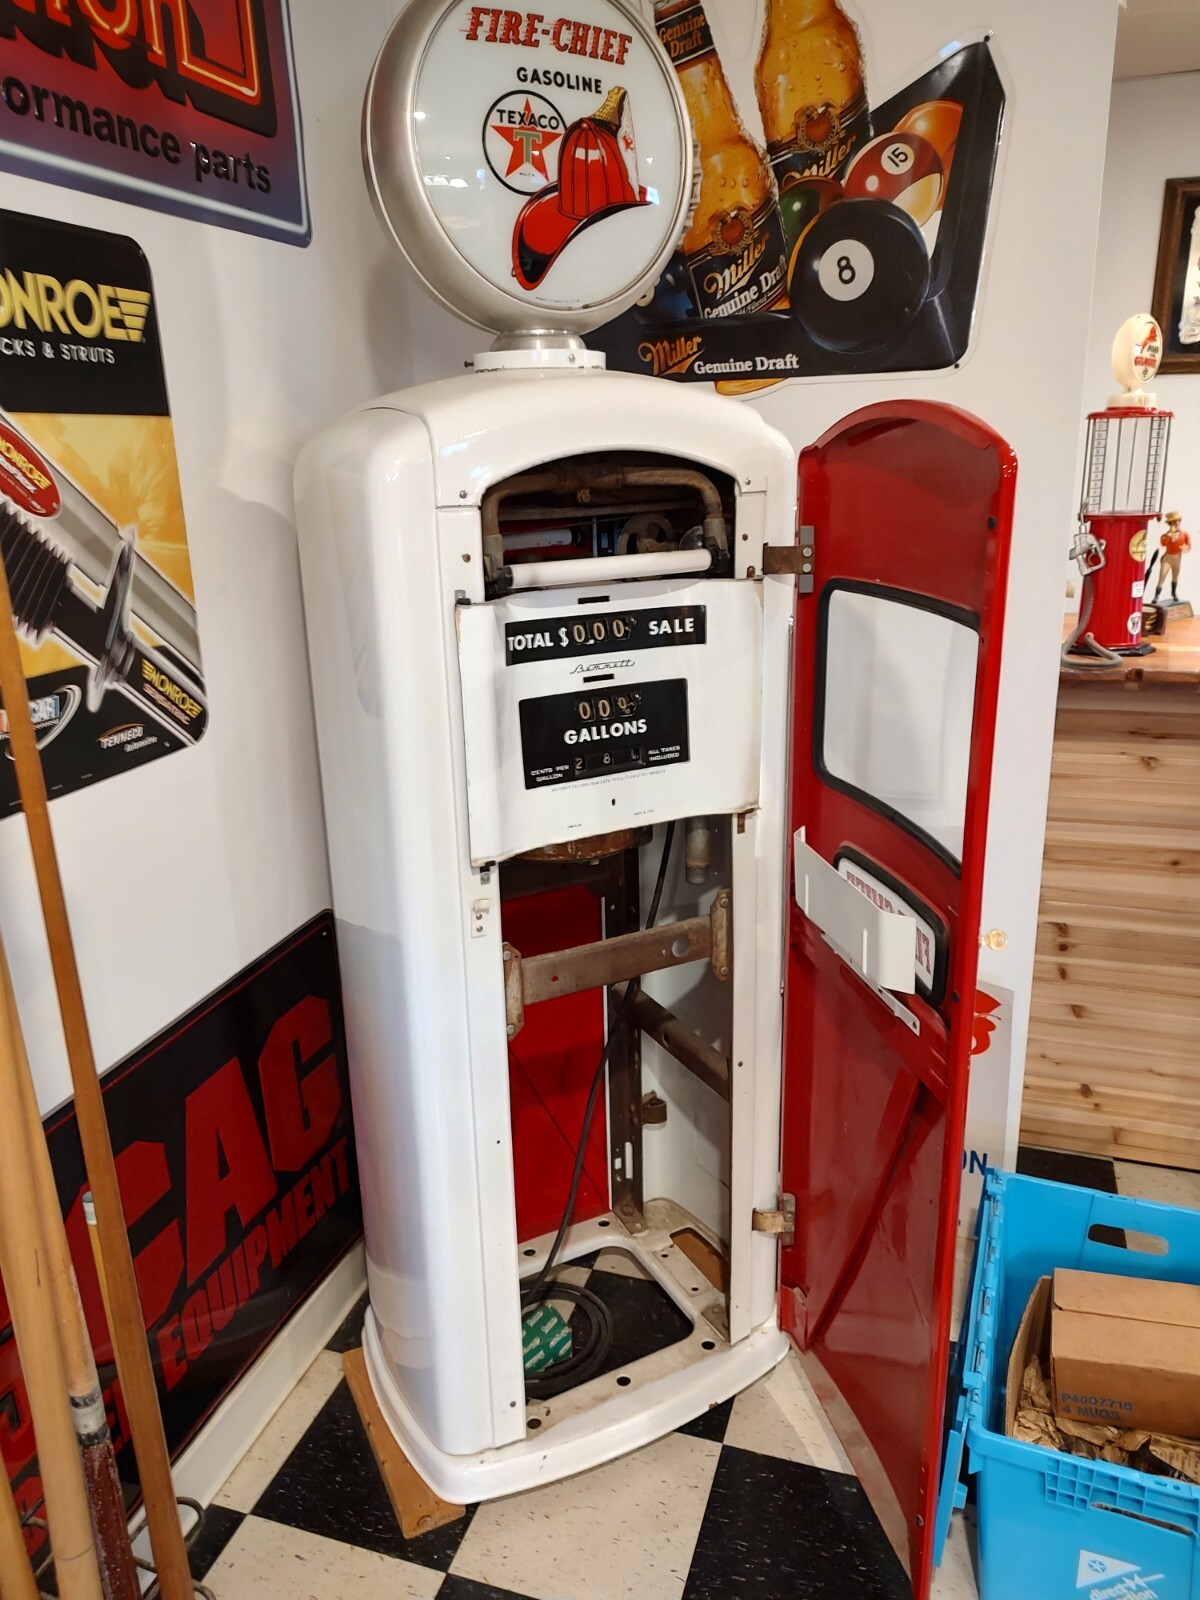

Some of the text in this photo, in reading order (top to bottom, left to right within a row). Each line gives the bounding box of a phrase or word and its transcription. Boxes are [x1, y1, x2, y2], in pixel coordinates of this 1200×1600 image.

[464, 5, 633, 66] FIRE-CHIEF
[659, 14, 706, 44] Genuine
[670, 30, 703, 58] Draft
[516, 66, 603, 95] GASOLINE
[496, 108, 560, 131] TEXACO
[190, 141, 271, 194] parts
[887, 147, 910, 168] 15
[836, 255, 856, 285] 8
[60, 344, 116, 364] STRUTS
[638, 336, 799, 377] Miller Genuine Draft
[507, 632, 554, 652] TOTAL
[649, 617, 695, 636] SALE
[142, 658, 203, 719] MONROE
[563, 719, 648, 745] GALLONS
[530, 767, 553, 776] CENTS
[536, 773, 564, 782] GALLON
[156, 1136, 349, 1393] EQUIPMENT
[1077, 1406, 1121, 1420] MUGS
